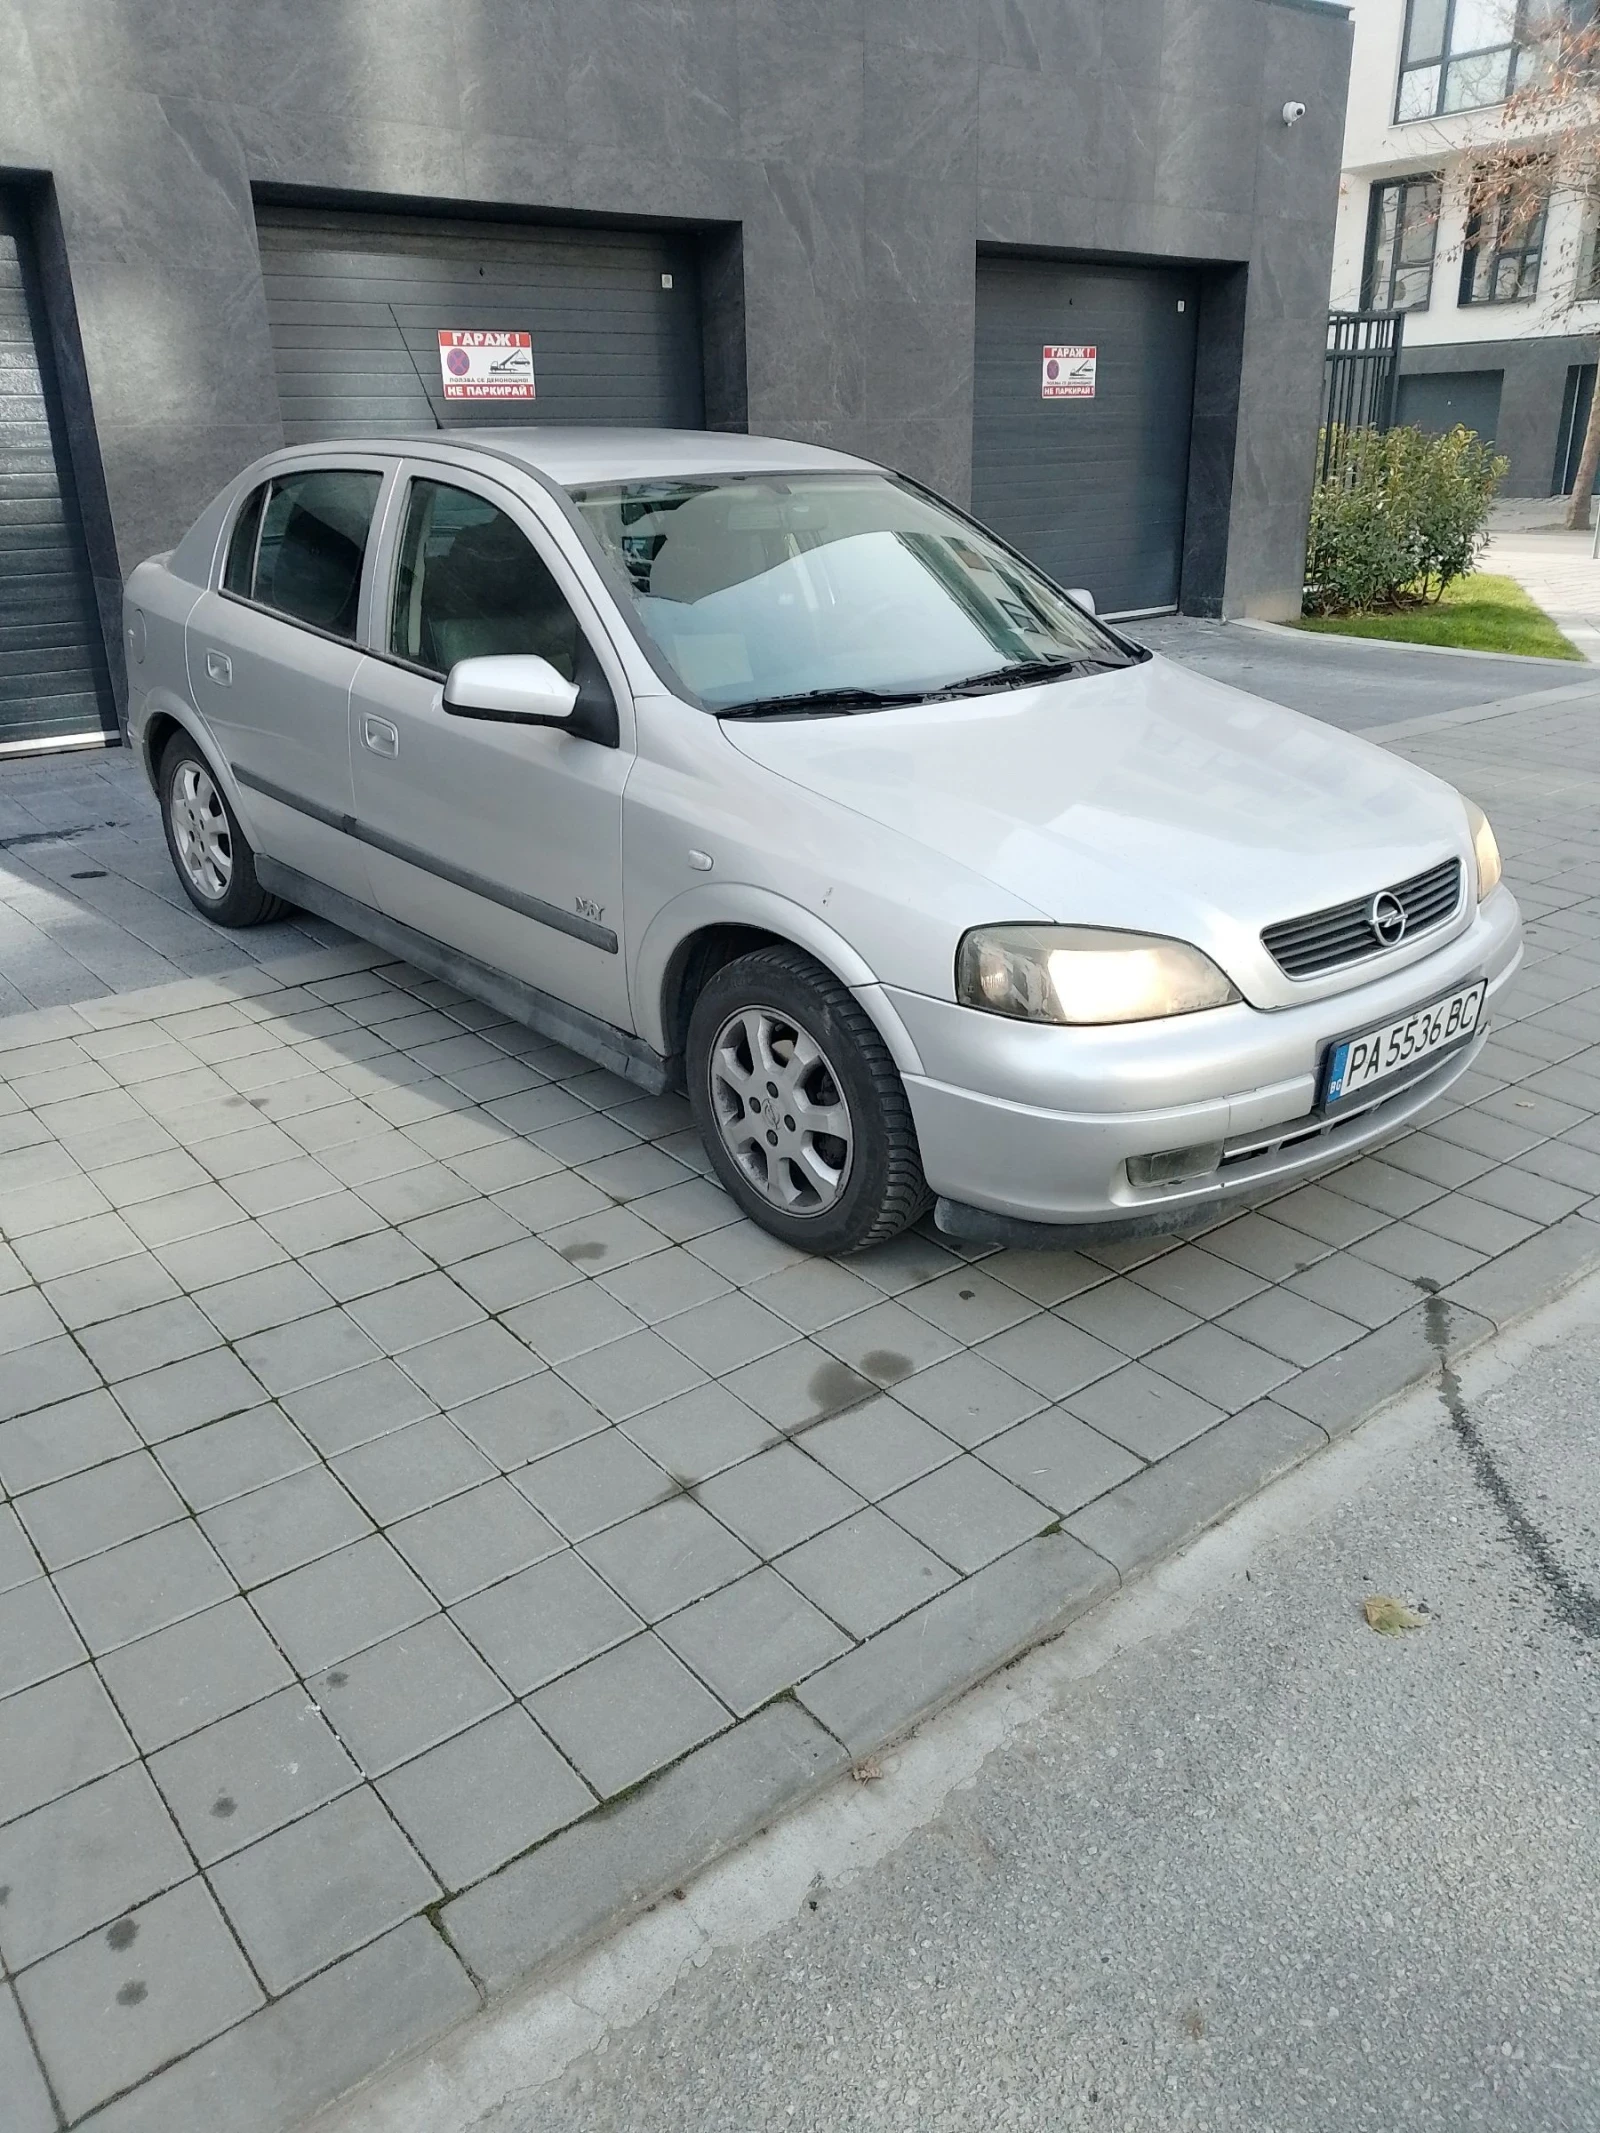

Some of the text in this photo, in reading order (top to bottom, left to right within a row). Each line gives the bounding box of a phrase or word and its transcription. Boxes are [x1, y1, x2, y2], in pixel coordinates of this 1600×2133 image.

[452, 332, 511, 346] ГАРАЖ
[1051, 348, 1084, 357] ГАРАЖ
[447, 386, 463, 396] НЕ
[466, 385, 527, 396] ПАРКИРАЙ
[1044, 387, 1053, 395] НЕ
[1347, 991, 1478, 1087] PA 5536 BC
[1330, 1079, 1342, 1094] BG
